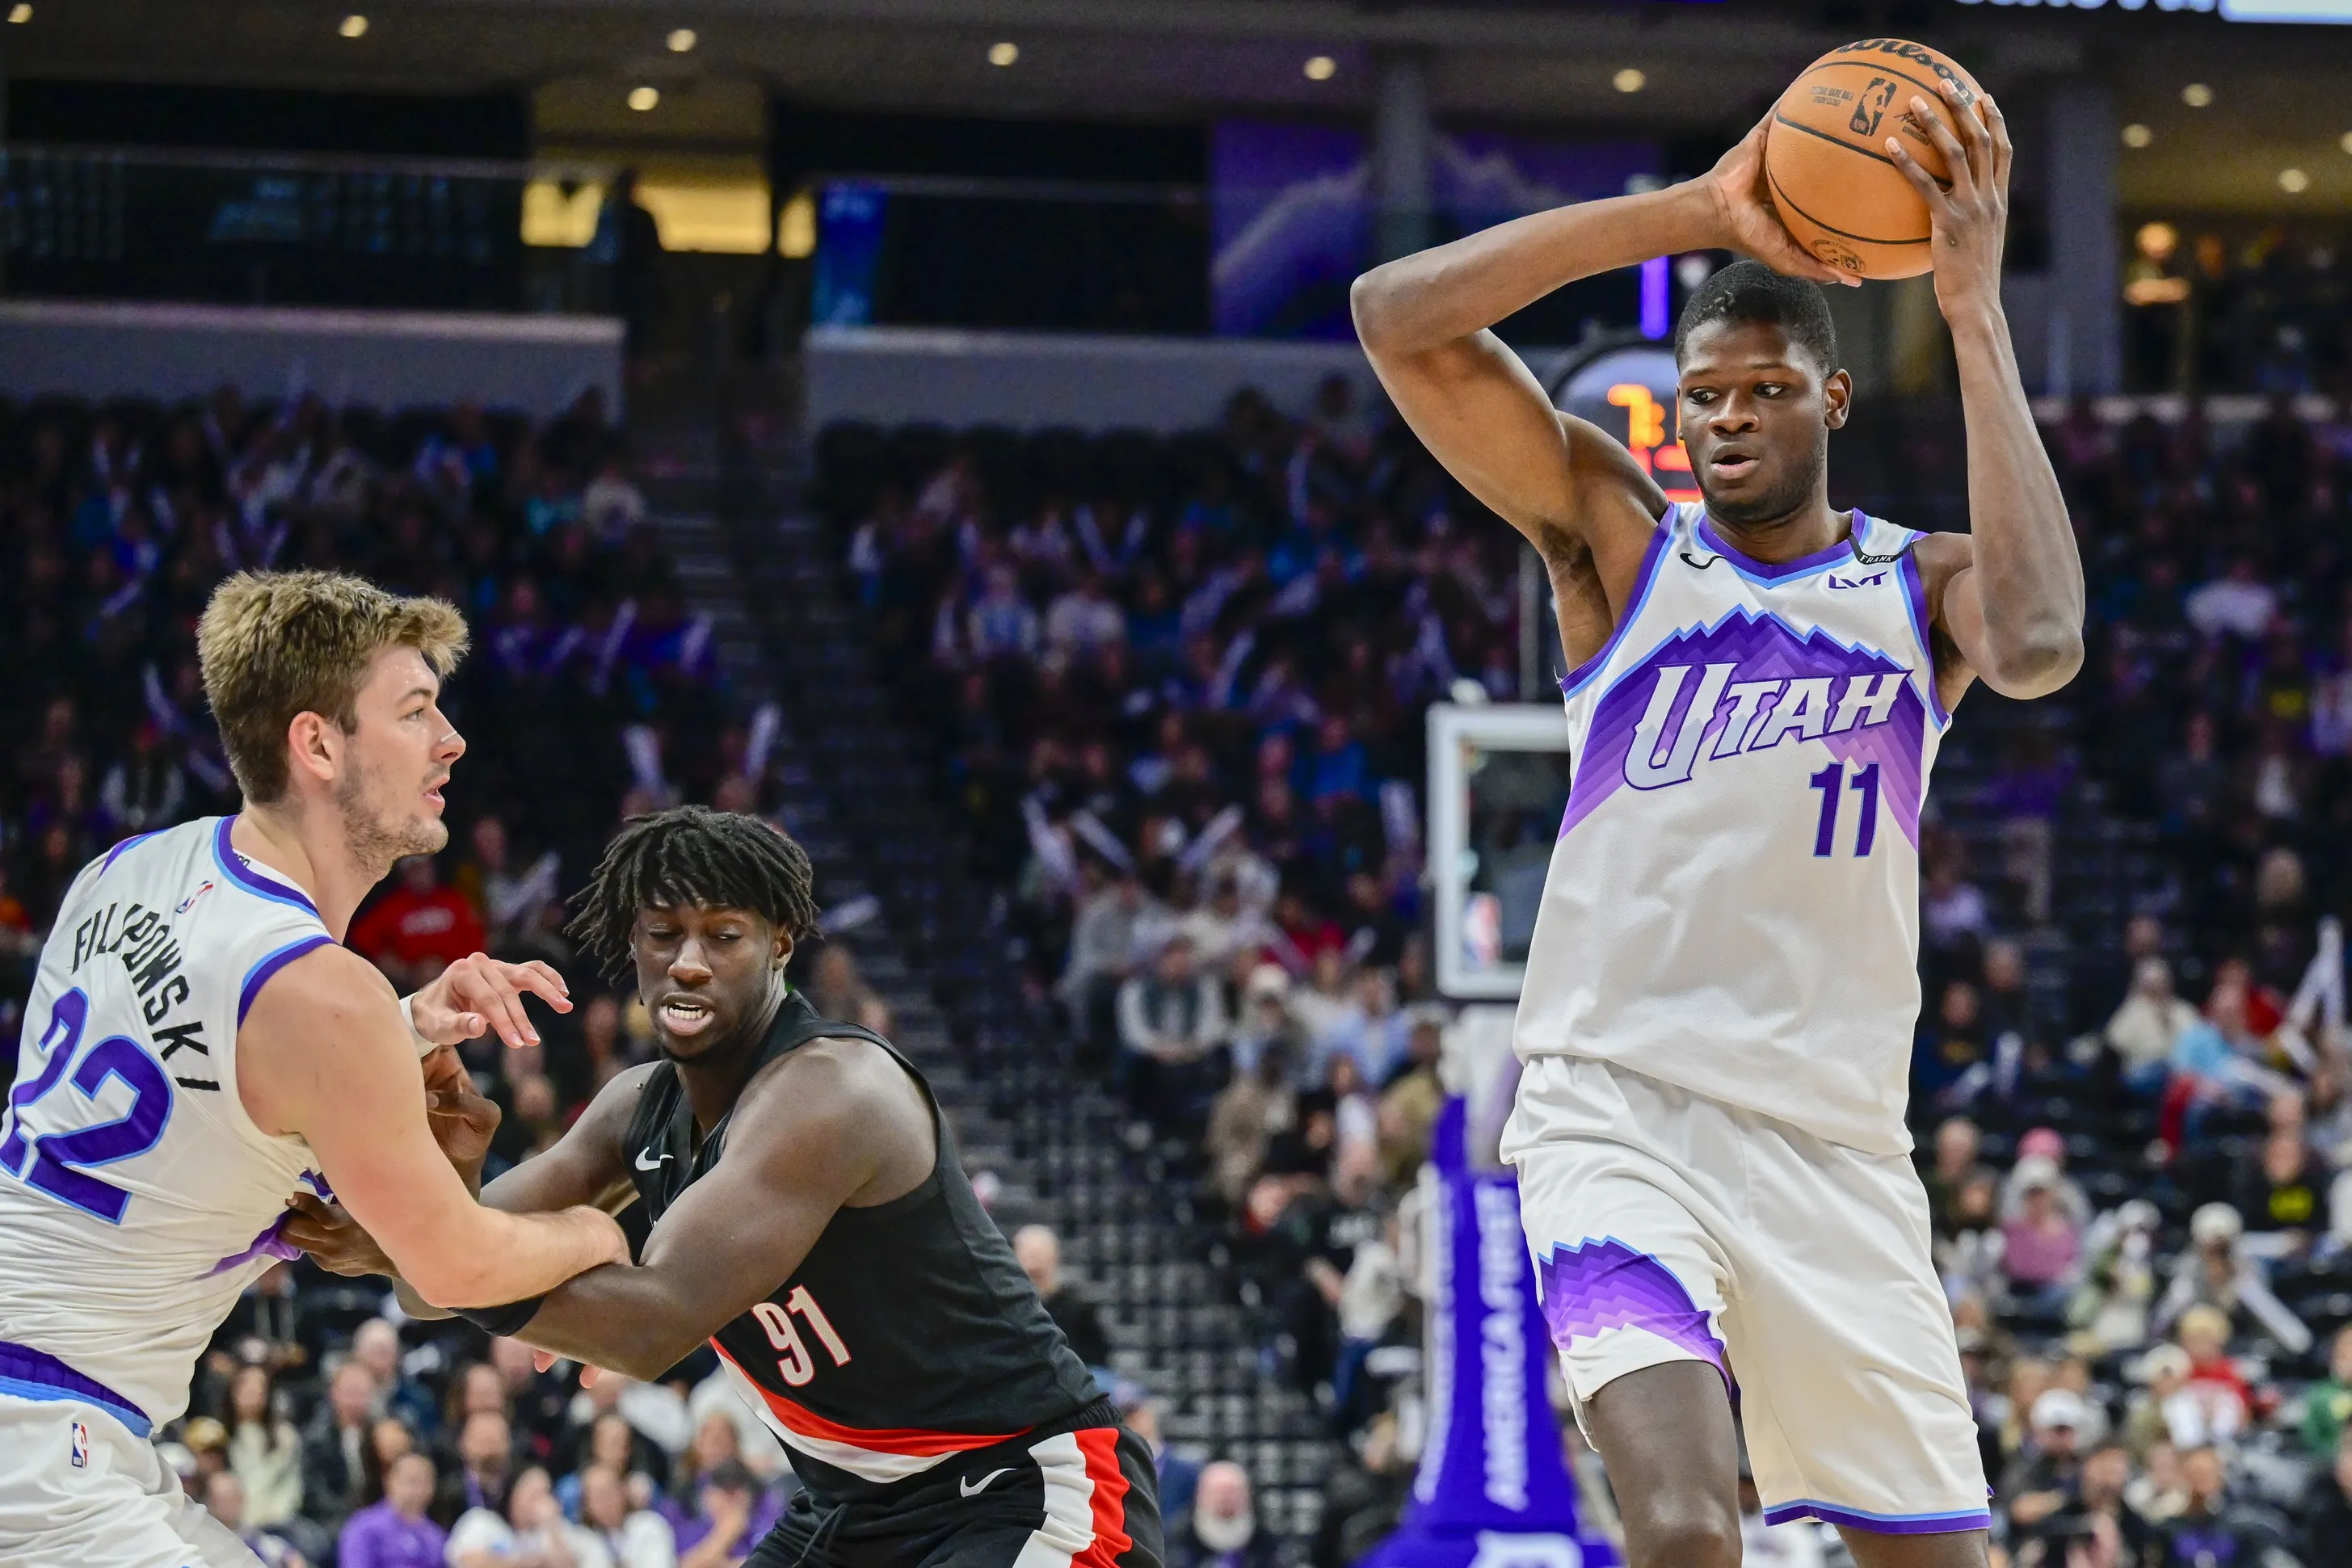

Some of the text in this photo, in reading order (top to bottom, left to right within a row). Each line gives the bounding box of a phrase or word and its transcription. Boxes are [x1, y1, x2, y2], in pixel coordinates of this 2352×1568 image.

[1828, 570, 1888, 590] LVT
[1859, 554, 1894, 564] FRANK
[1622, 658, 1914, 791] UTAH
[1809, 761, 1882, 859] 11
[0, 986, 175, 1226] 22
[751, 1284, 852, 1387] 91
